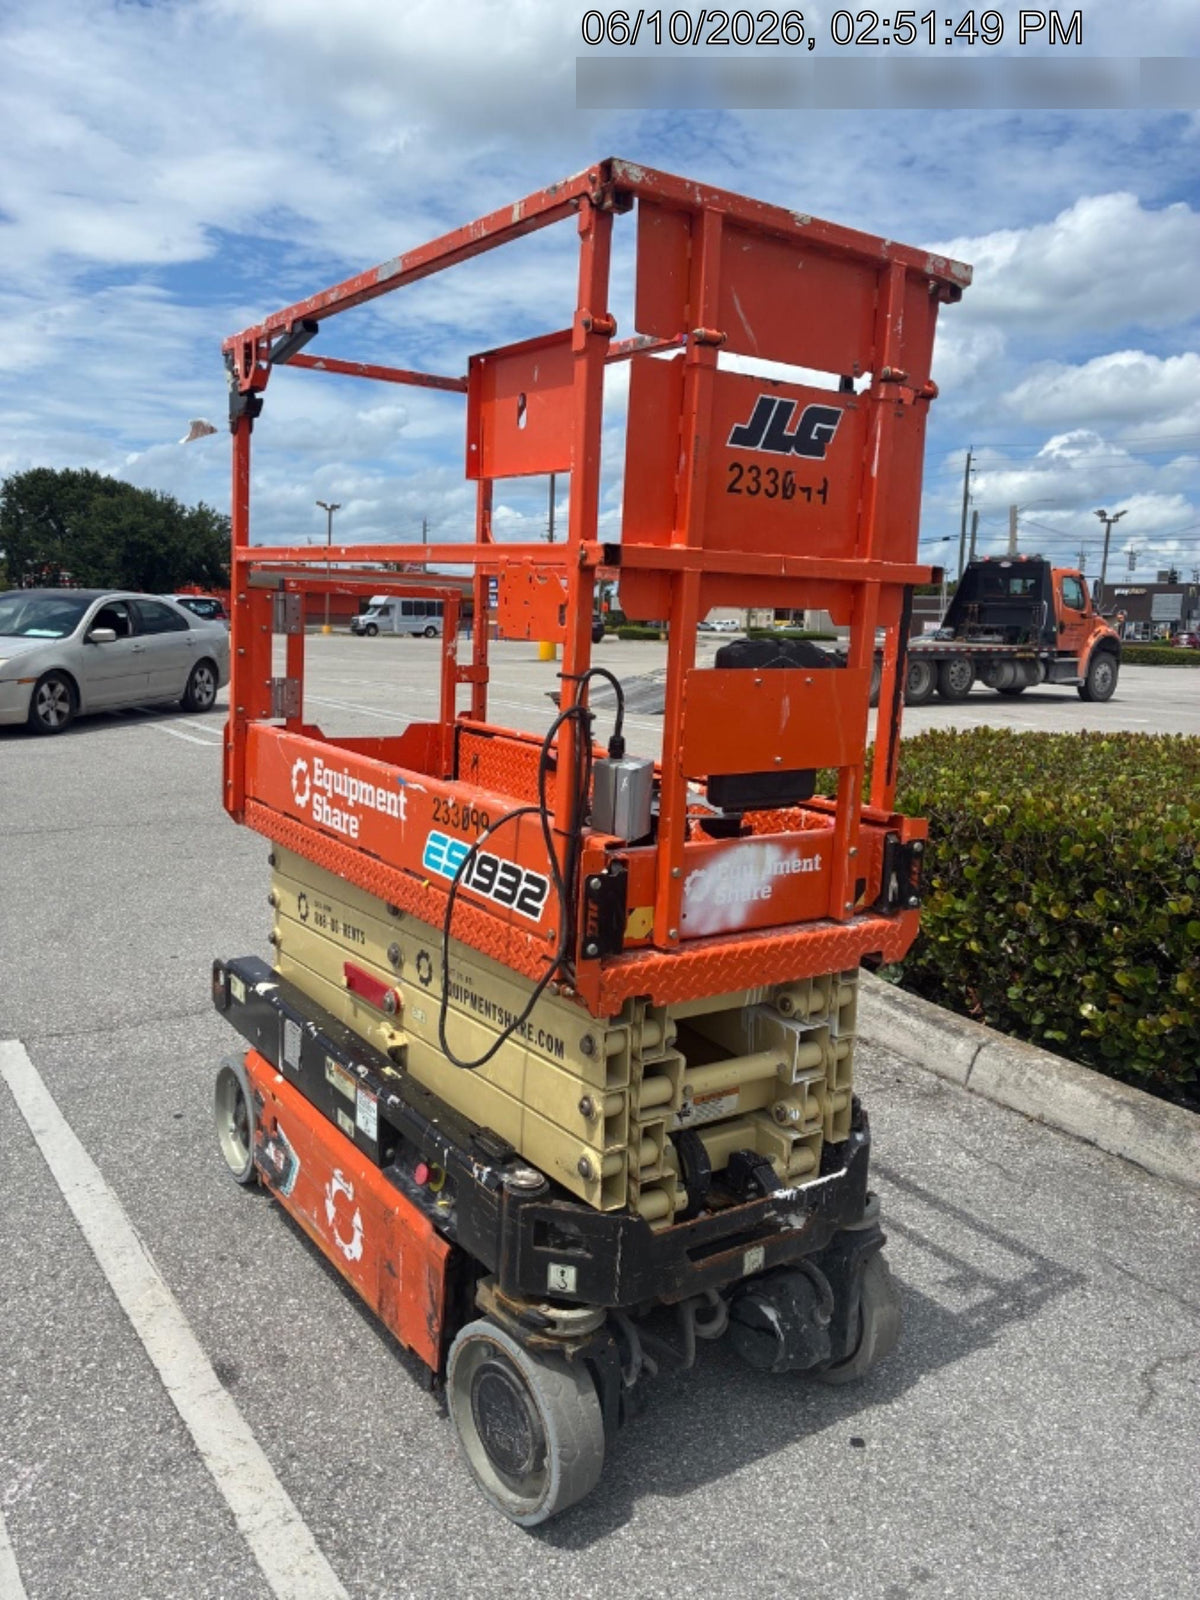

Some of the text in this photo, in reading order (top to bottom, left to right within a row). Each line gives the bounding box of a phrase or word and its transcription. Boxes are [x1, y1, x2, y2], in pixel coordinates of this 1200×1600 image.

[725, 394, 844, 461] JLG
[312, 757, 408, 821] Equipment
[312, 792, 360, 839] Share
[423, 829, 550, 923] ES1932
[718, 853, 823, 880] Equment
[447, 979, 565, 1060] QUIPMENTSHARE.COM
